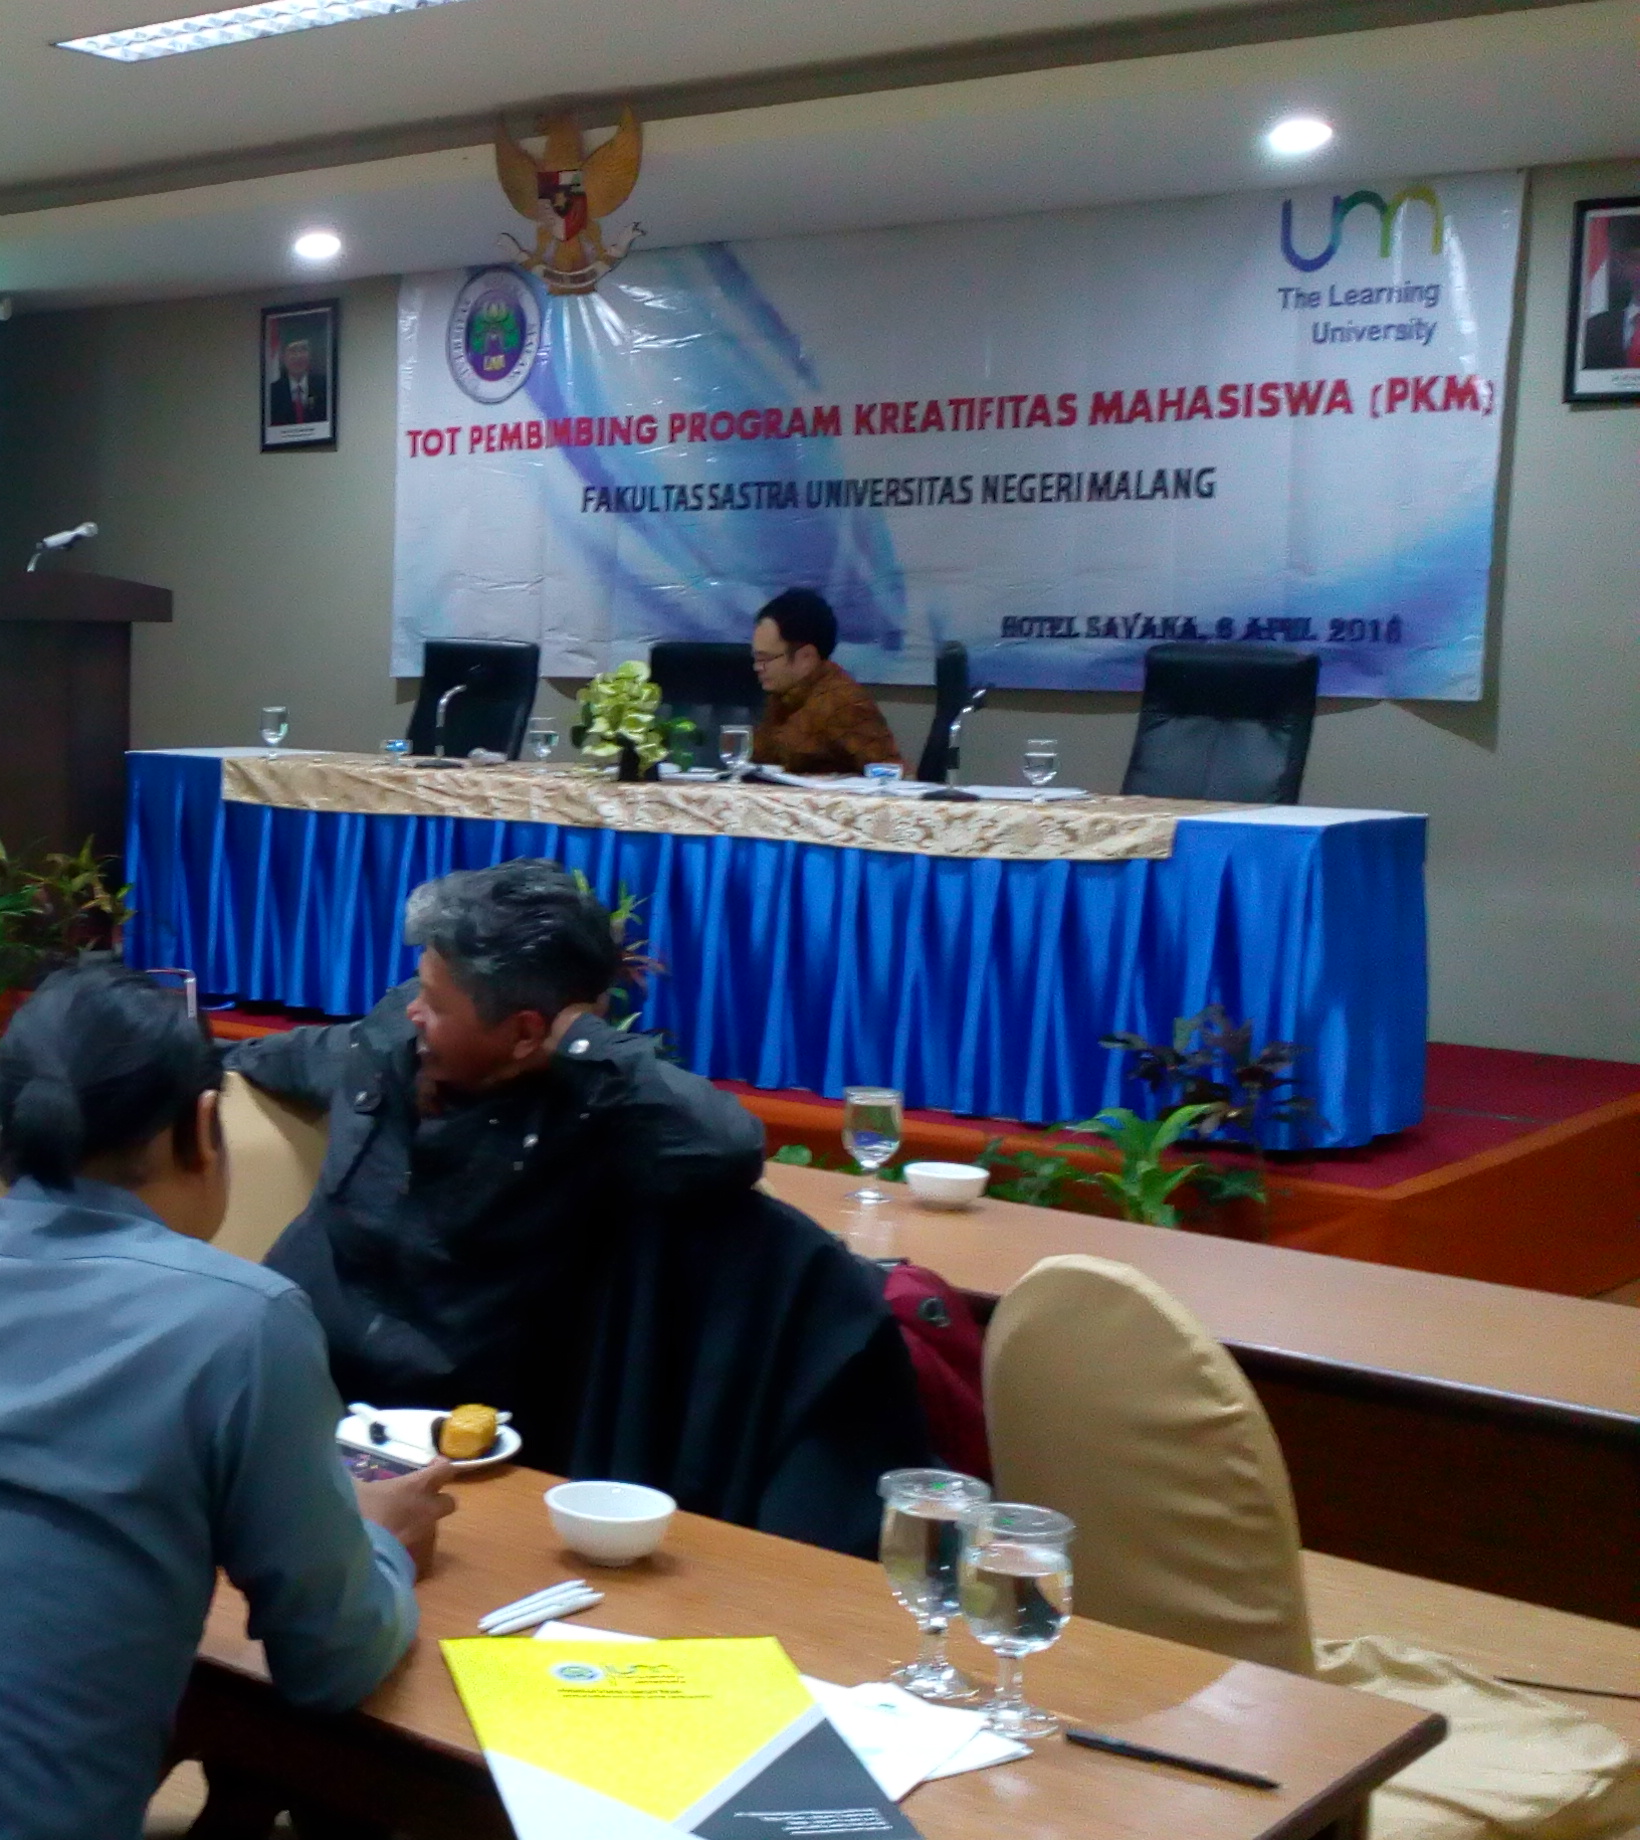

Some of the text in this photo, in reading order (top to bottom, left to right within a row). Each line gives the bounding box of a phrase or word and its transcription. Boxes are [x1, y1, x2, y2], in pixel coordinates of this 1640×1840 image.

[1278, 281, 1441, 311] The Learning
[1312, 317, 1438, 346] University
[406, 374, 1495, 458] TOT PEMBIMBING PROGRAM KREATIFITAS MAHASISWA (PKM)
[580, 466, 1217, 513] FAKULTAS SASTRA UNIVERSITAS NEGERI MALANG
[1000, 615, 1081, 639] HOTEL
